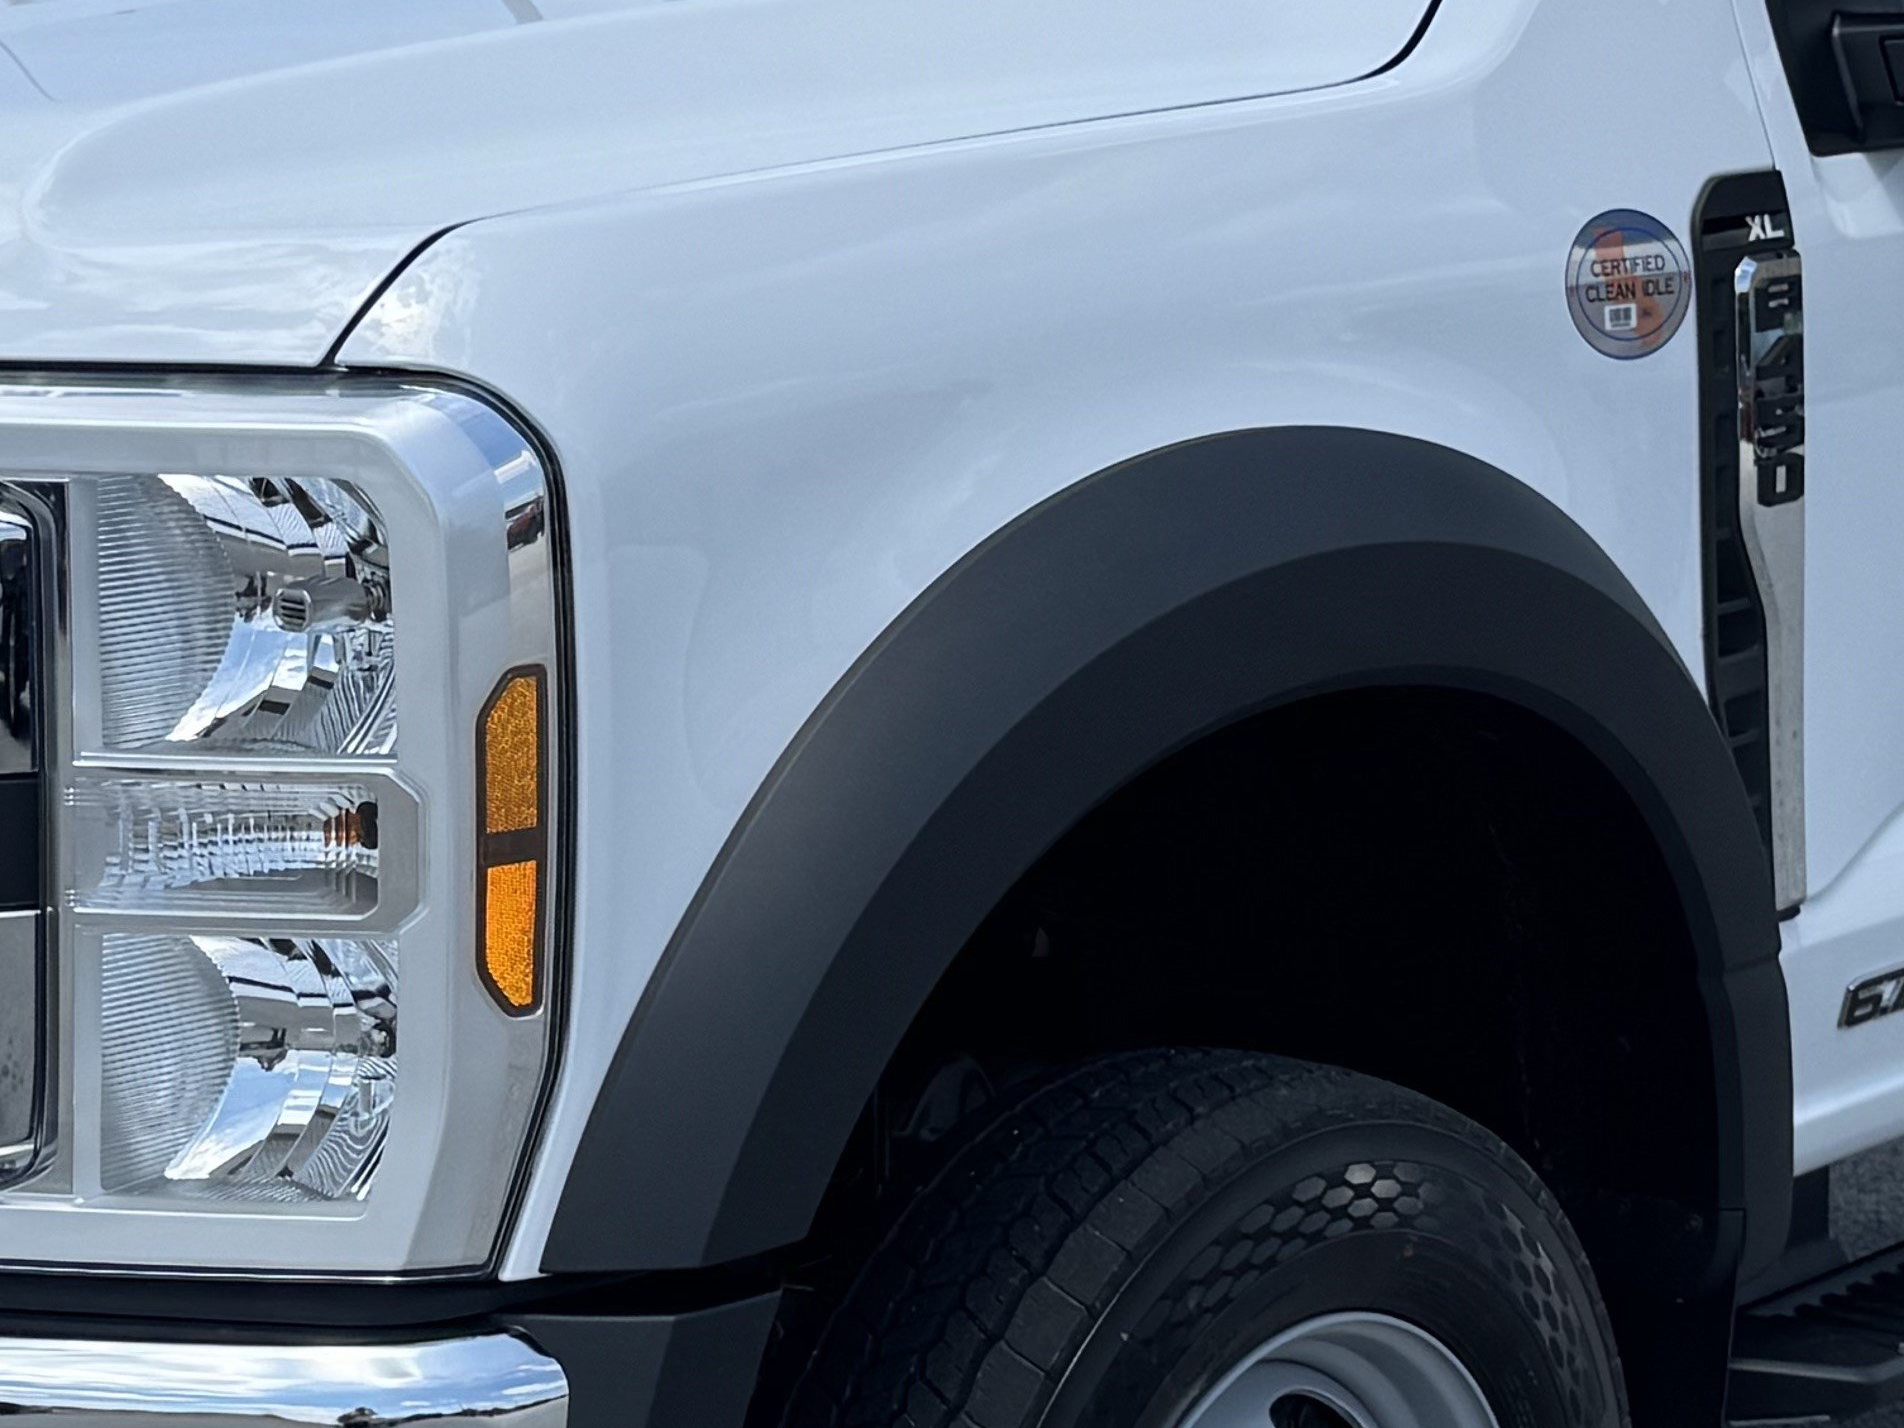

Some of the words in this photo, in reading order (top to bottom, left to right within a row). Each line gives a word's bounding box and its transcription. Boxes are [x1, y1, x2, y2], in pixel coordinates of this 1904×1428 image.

[1746, 215, 1784, 241] XL
[1590, 254, 1666, 278] CERTIFIED
[1584, 282, 1636, 303] CLEAN
[1641, 278, 1675, 298] IDLE
